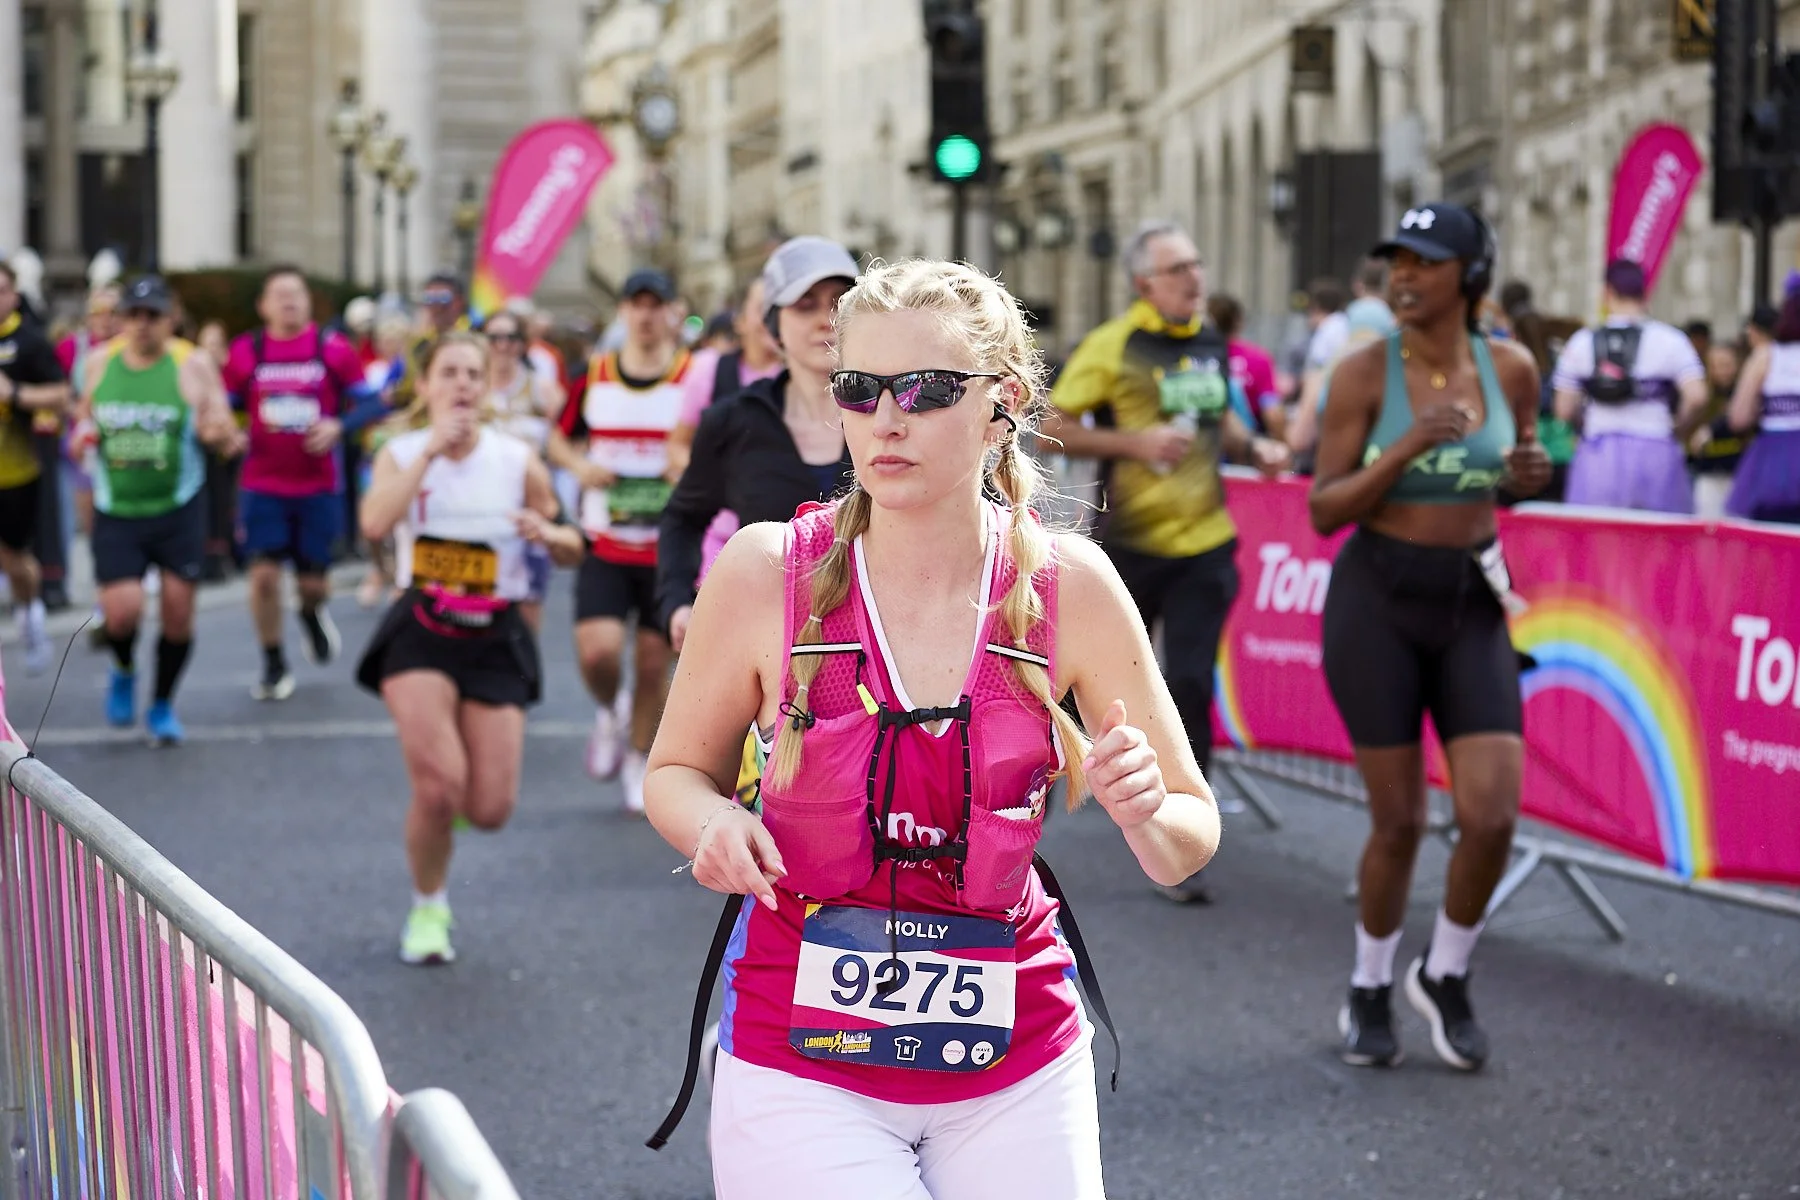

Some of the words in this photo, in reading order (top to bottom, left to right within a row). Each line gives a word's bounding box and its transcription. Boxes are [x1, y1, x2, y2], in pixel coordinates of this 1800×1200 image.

[1732, 614, 1800, 708] To
[885, 920, 949, 939] MOLLY
[830, 954, 984, 1017] 9275
[804, 1036, 834, 1048] LONDON
[978, 1052, 985, 1061] 4
